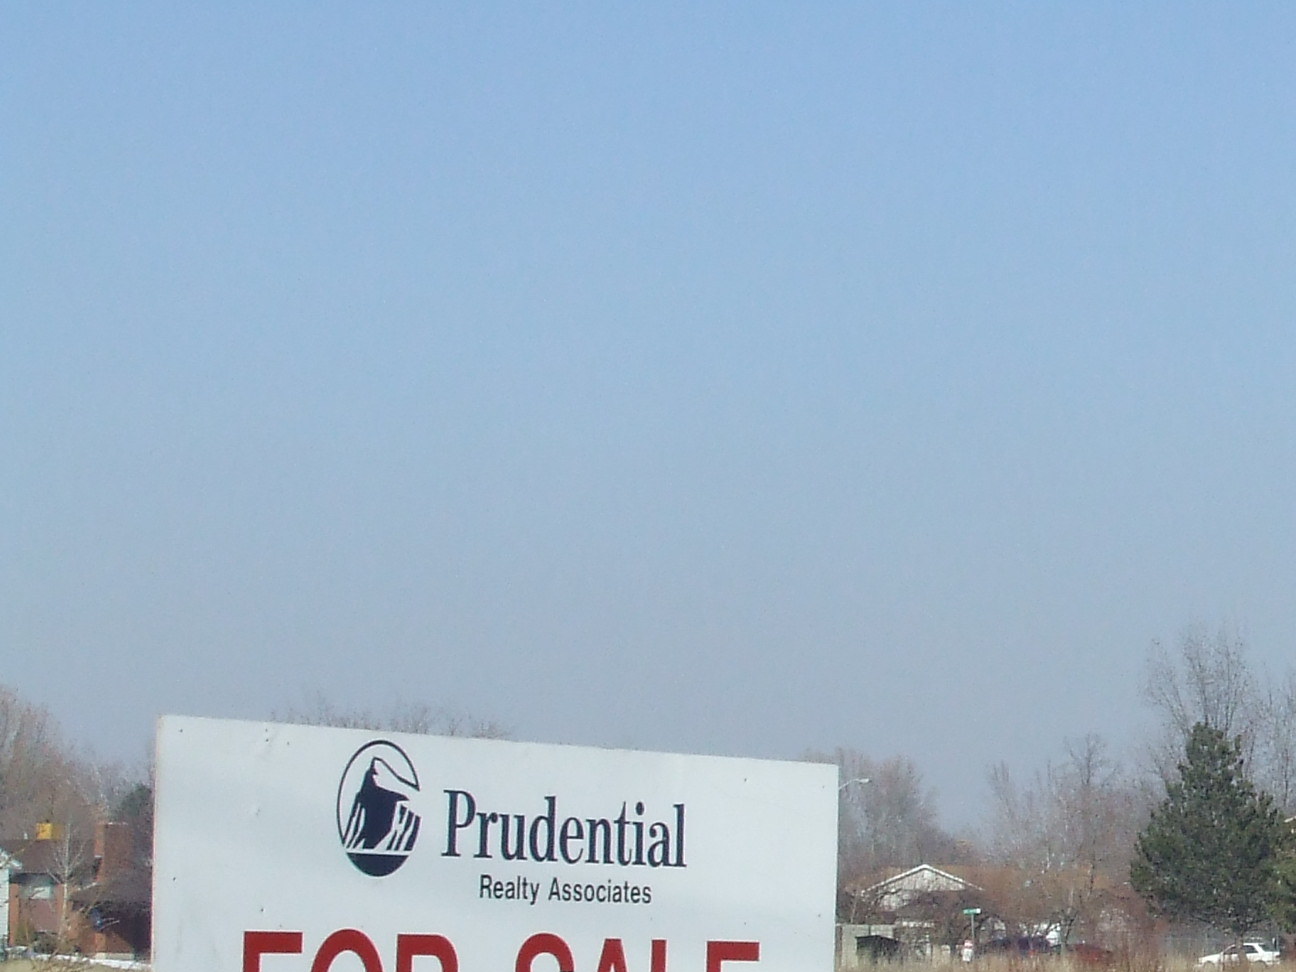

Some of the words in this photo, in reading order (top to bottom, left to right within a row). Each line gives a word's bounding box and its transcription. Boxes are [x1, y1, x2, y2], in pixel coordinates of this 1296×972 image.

[441, 789, 687, 868] Prudential
[479, 874, 540, 906] Realty
[547, 876, 652, 904] Associates
